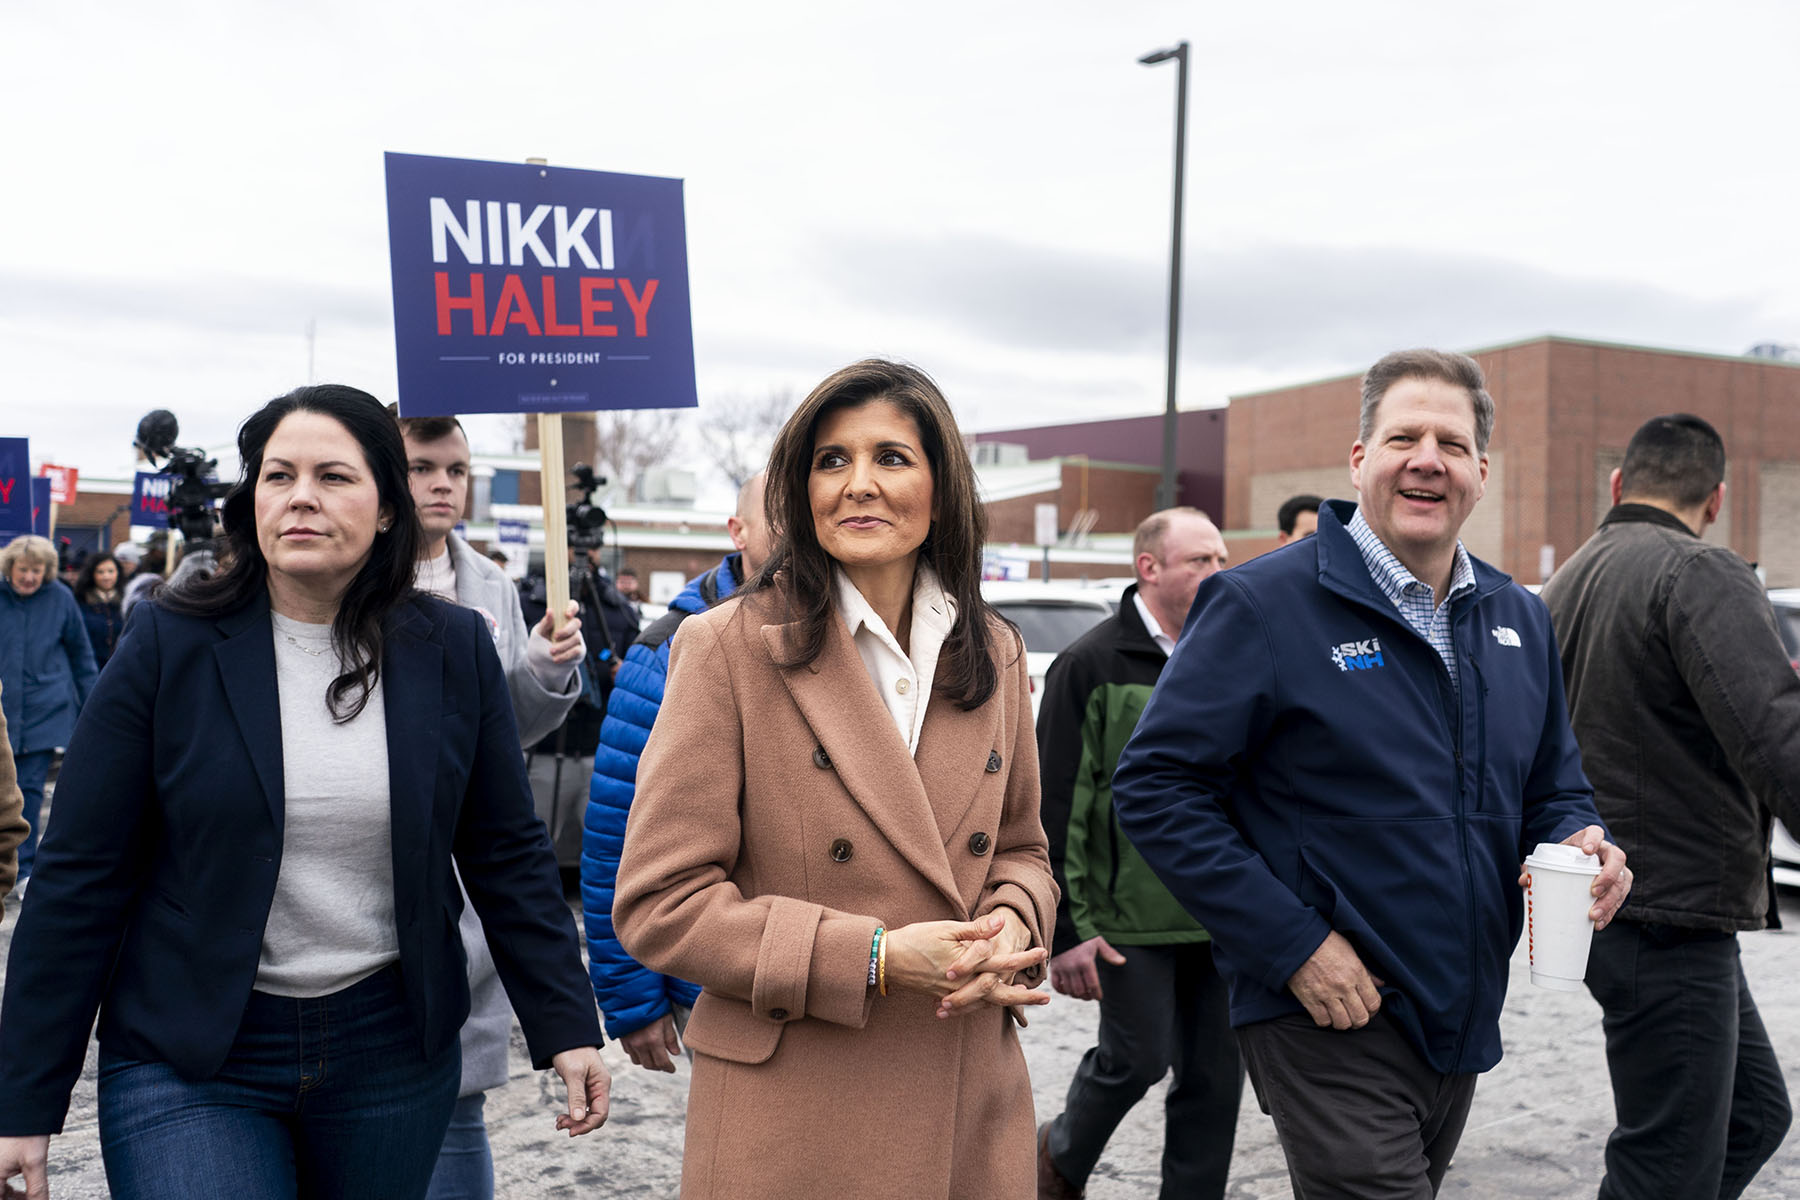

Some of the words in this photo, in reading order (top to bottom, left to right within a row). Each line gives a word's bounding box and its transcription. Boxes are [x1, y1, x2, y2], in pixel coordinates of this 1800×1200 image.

[430, 197, 615, 270] NIKKI
[434, 271, 660, 337] HALEY
[498, 352, 525, 364] FOR
[531, 352, 600, 365] PRESIDENT
[1345, 651, 1384, 671] NH
